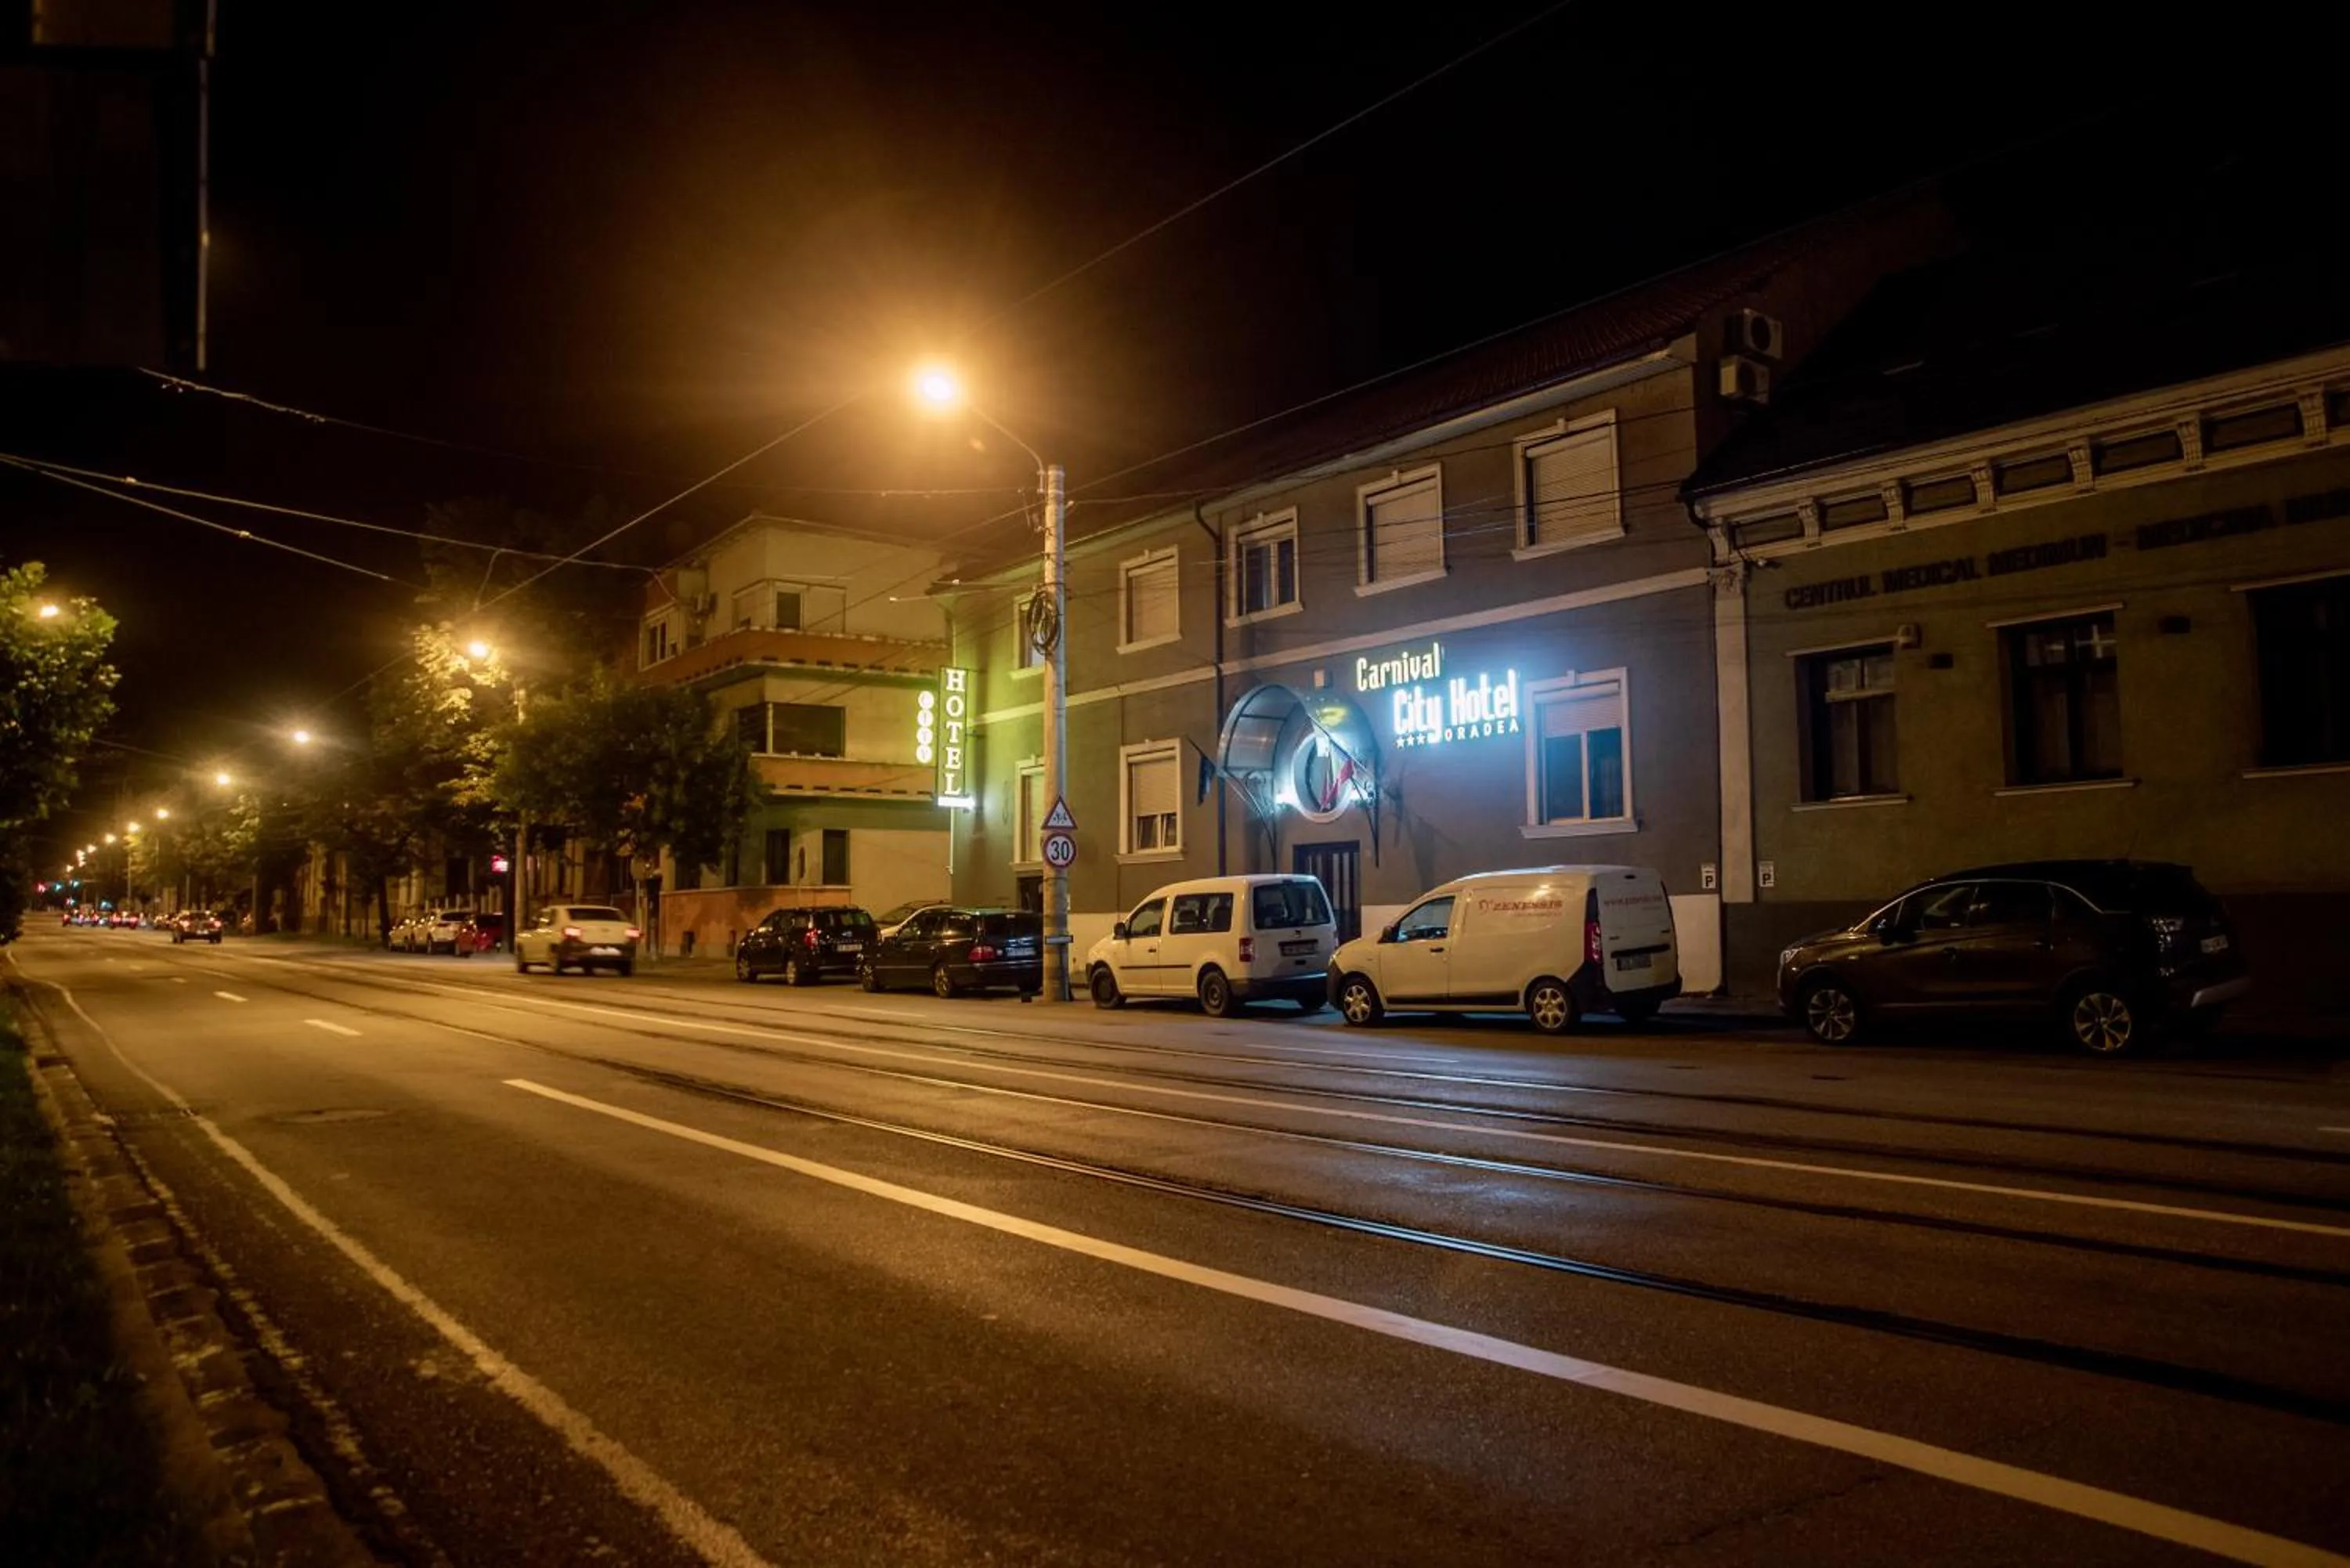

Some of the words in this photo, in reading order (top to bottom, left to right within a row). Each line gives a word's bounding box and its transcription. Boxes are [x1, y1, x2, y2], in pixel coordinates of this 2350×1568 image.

[1785, 575, 1877, 609] CENTRUL
[1882, 556, 1982, 594] MEDICAL
[1356, 641, 1441, 692] Carnival
[1394, 685, 1442, 744] City
[1449, 668, 1518, 727] Hotel
[944, 668, 965, 796] HOTEL
[1444, 718, 1520, 742] ORADEA
[1050, 840, 1070, 862] 30
[1705, 875, 1713, 887] P
[1762, 873, 1771, 886] P
